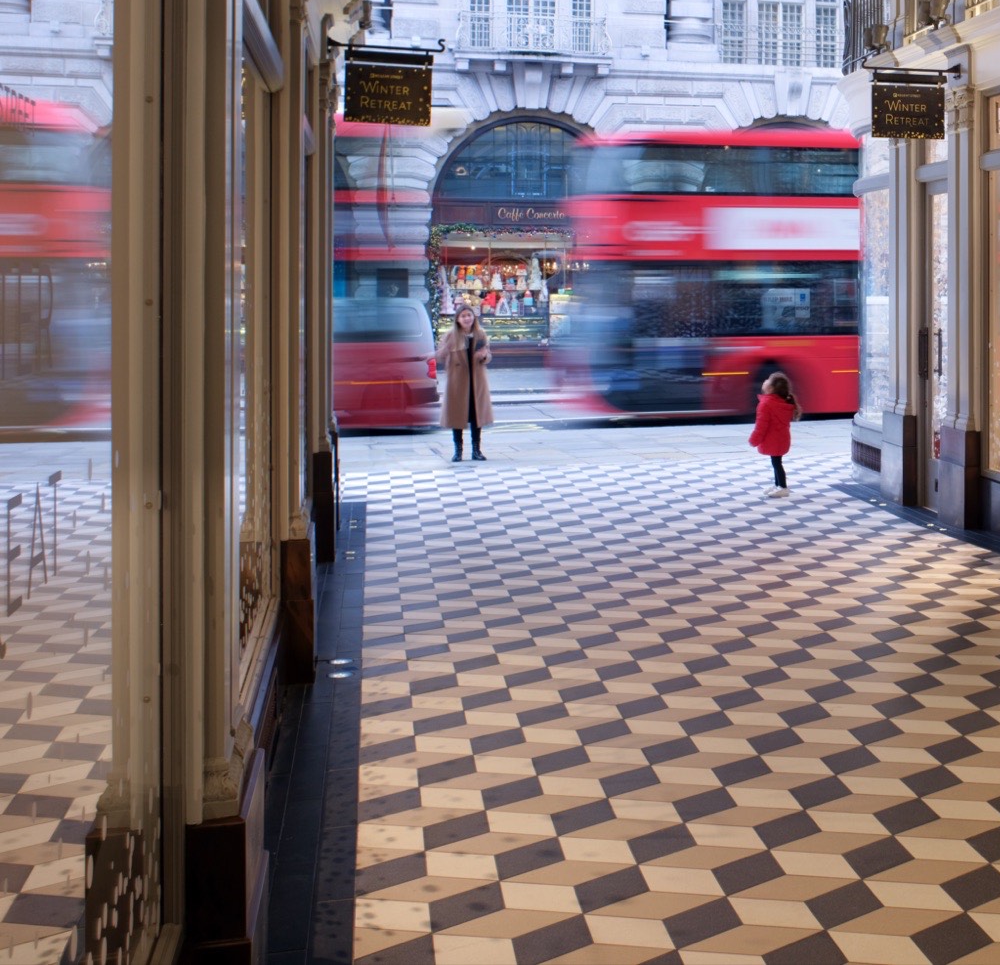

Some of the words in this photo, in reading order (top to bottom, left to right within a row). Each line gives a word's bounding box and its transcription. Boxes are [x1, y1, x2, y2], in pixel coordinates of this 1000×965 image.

[359, 80, 410, 96] WINTER
[360, 95, 413, 112] RETREAT
[884, 99, 927, 113] WINTER
[886, 113, 929, 127] RETREAT
[526, 207, 565, 220] Concerto
